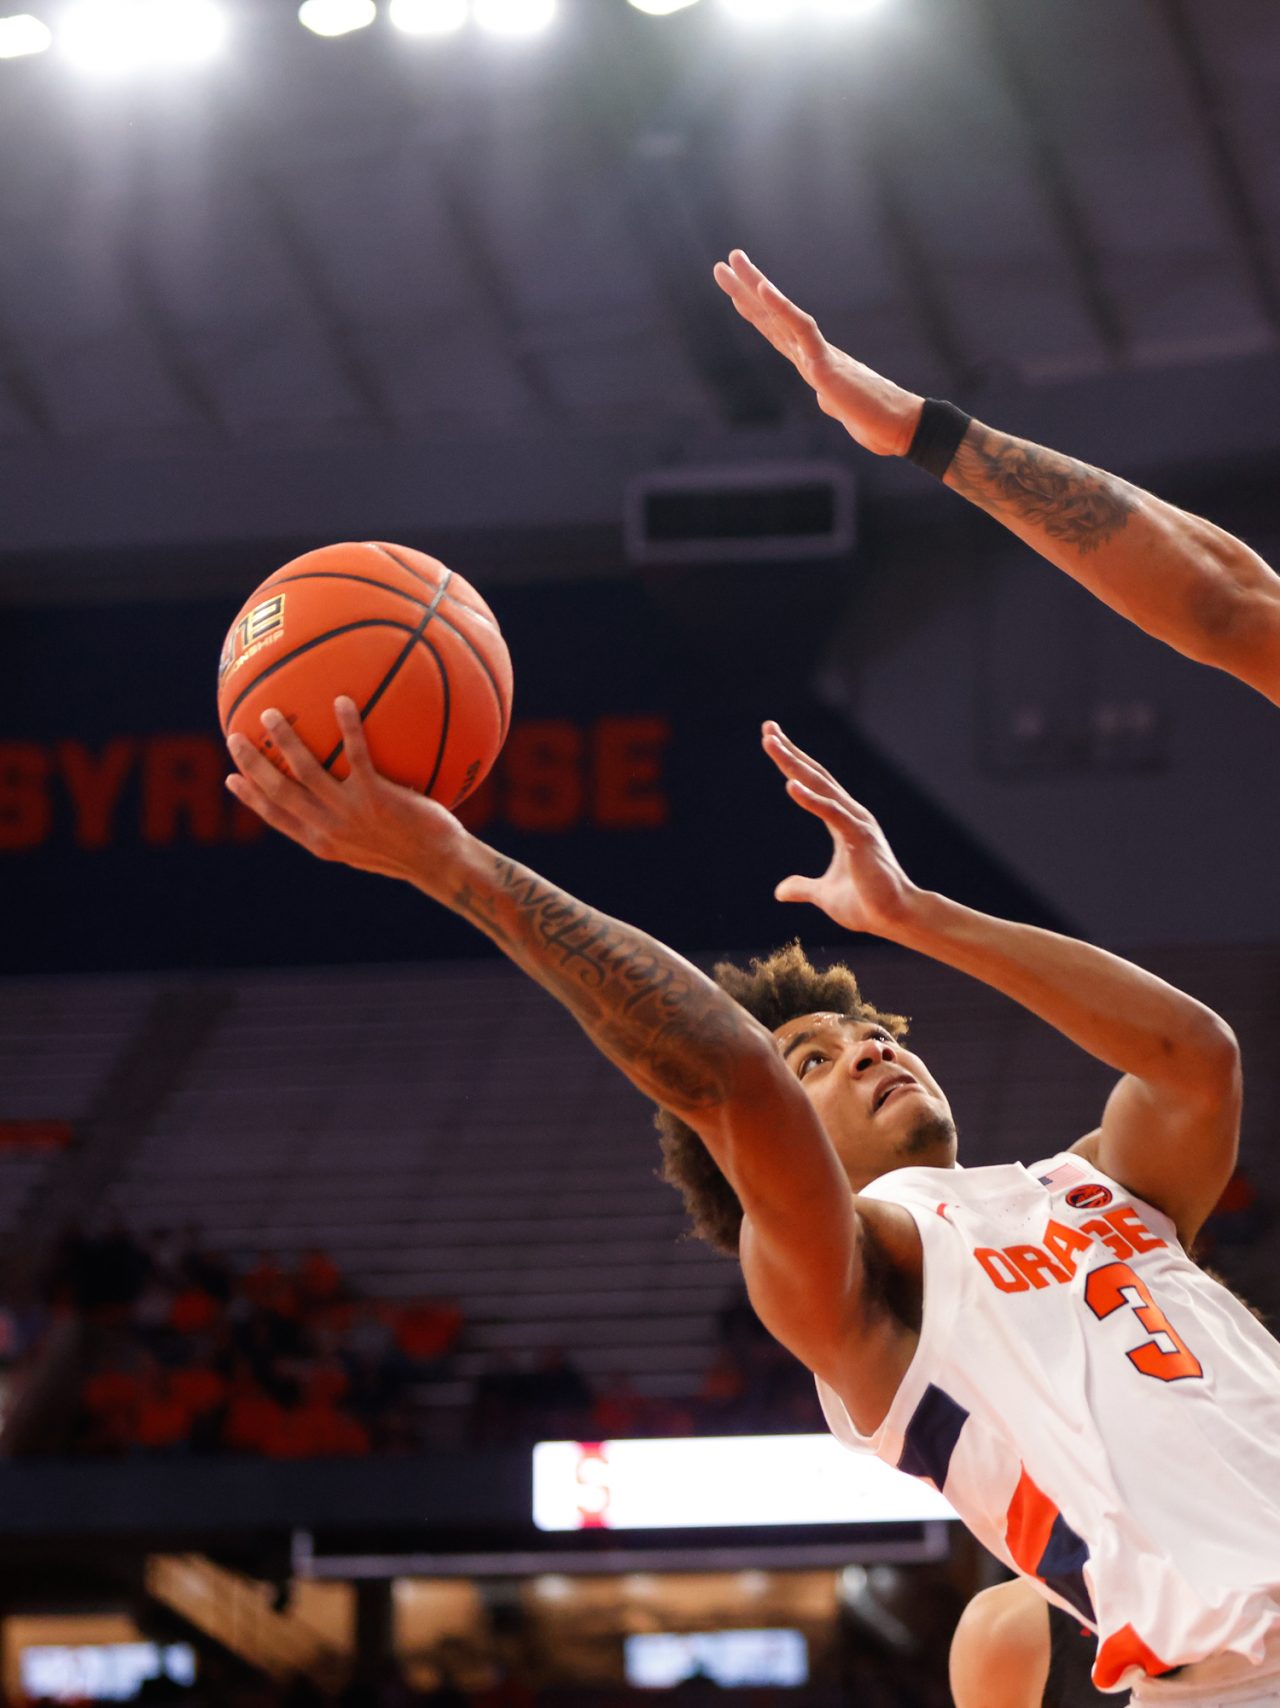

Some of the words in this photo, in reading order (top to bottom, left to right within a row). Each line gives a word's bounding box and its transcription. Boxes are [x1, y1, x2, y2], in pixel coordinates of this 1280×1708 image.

[0, 716, 670, 850] SYRSE
[973, 1206, 1169, 1294] ORAGE
[1083, 1260, 1204, 1384] 3
